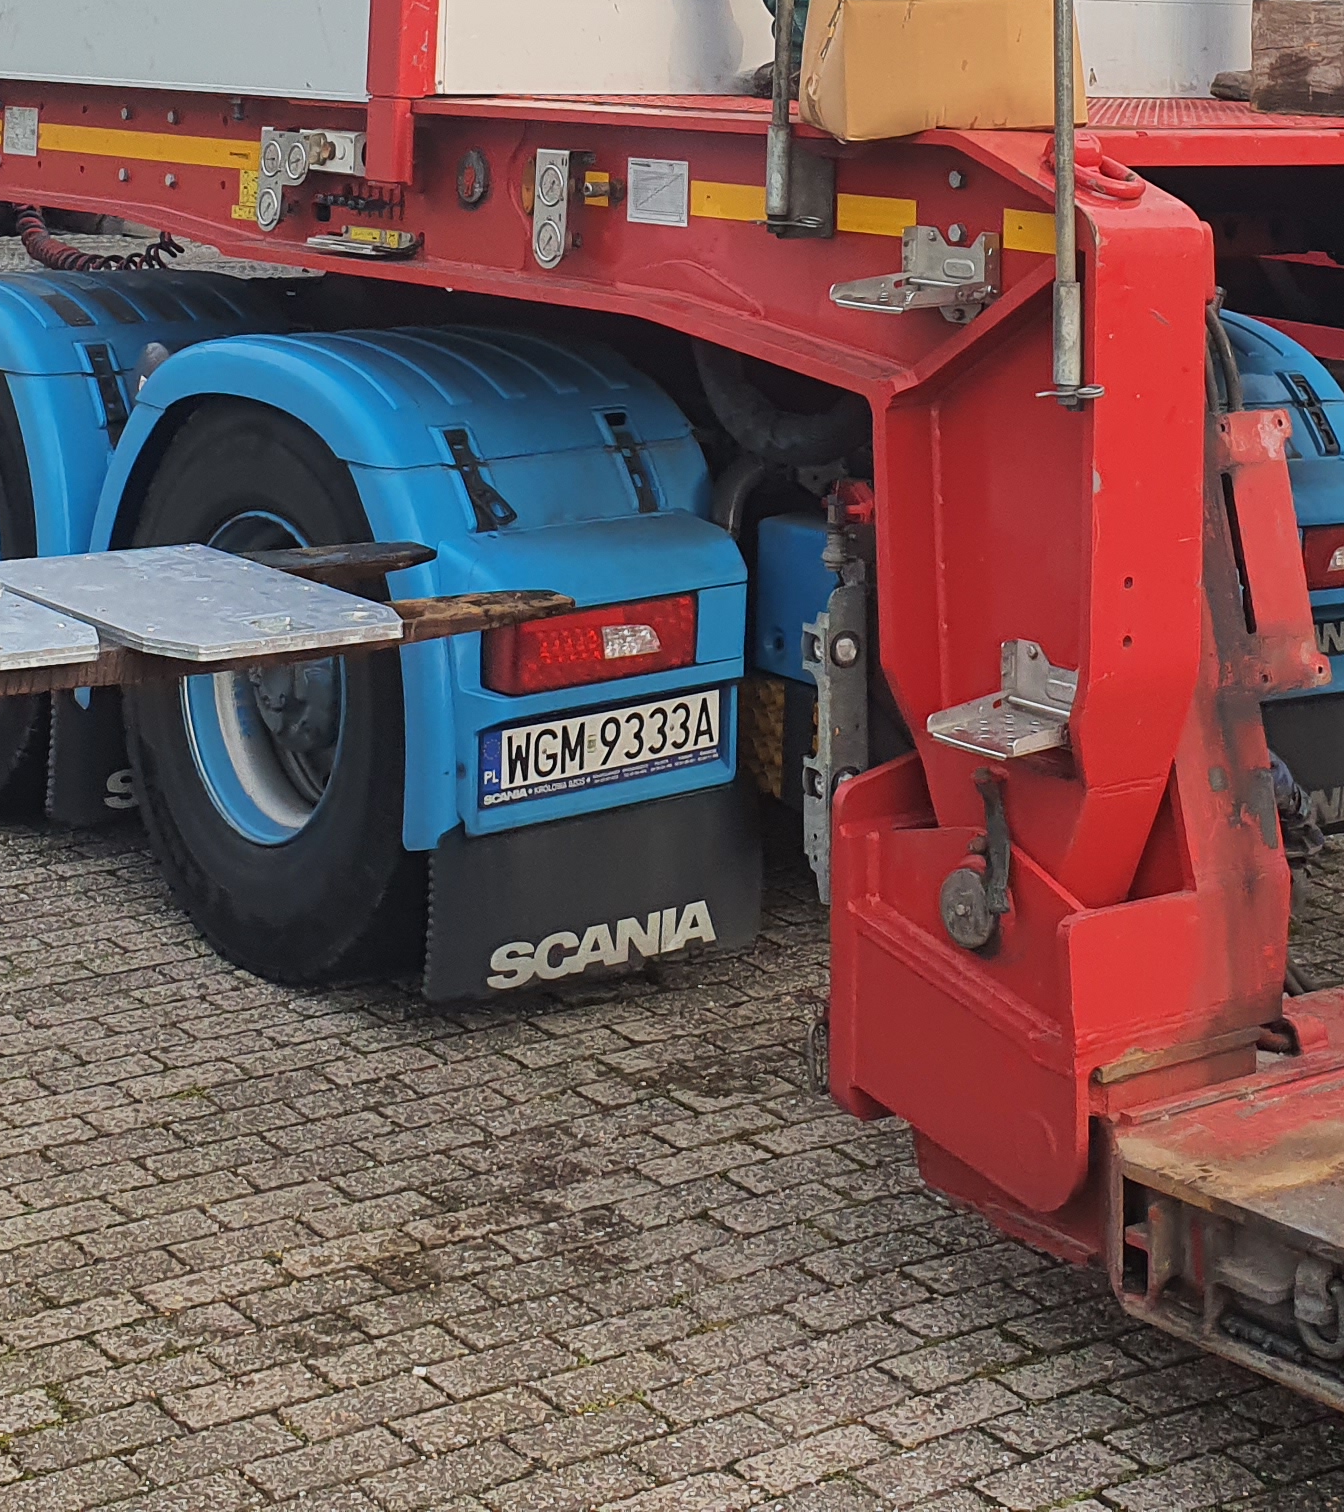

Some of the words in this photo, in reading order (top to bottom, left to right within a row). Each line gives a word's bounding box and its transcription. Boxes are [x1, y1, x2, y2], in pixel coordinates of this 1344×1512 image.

[506, 722, 586, 785] WGM
[599, 697, 715, 767] 9333A
[483, 770, 500, 785] PL
[483, 787, 528, 806] SCANIA
[486, 899, 718, 988] SCANIA
